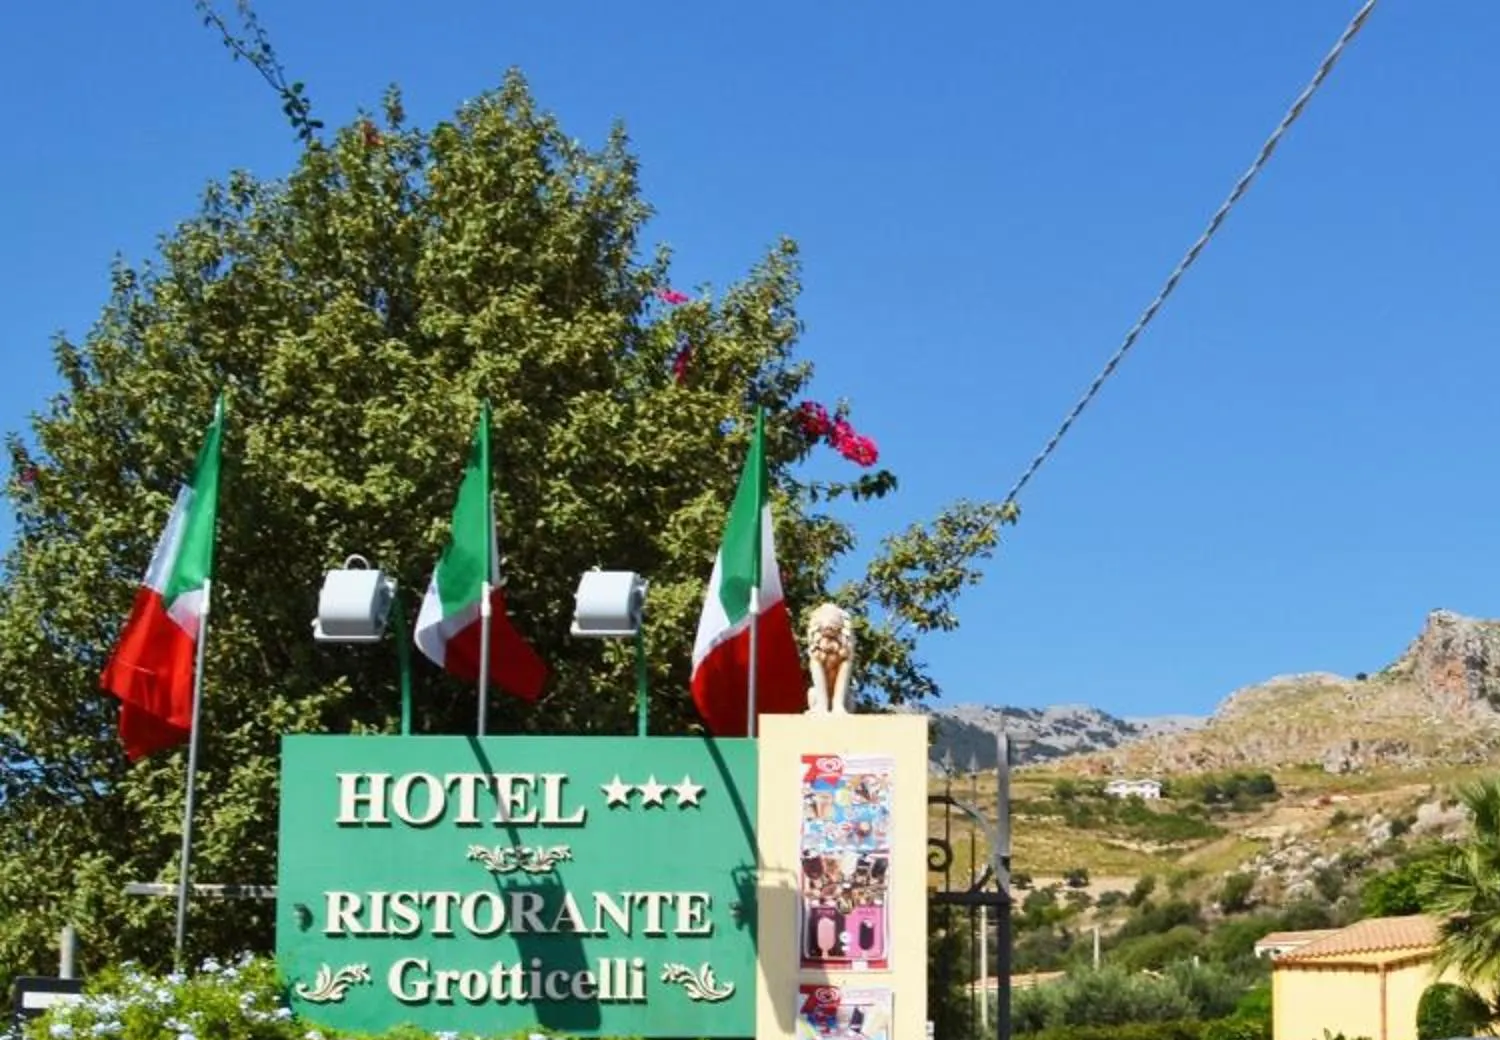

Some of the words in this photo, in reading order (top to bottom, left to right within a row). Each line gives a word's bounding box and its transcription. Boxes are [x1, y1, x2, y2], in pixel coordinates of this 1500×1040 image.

[336, 772, 586, 823] HOTEL
[321, 888, 714, 935] RISTORANTE
[387, 956, 648, 1001] Grotticelli
